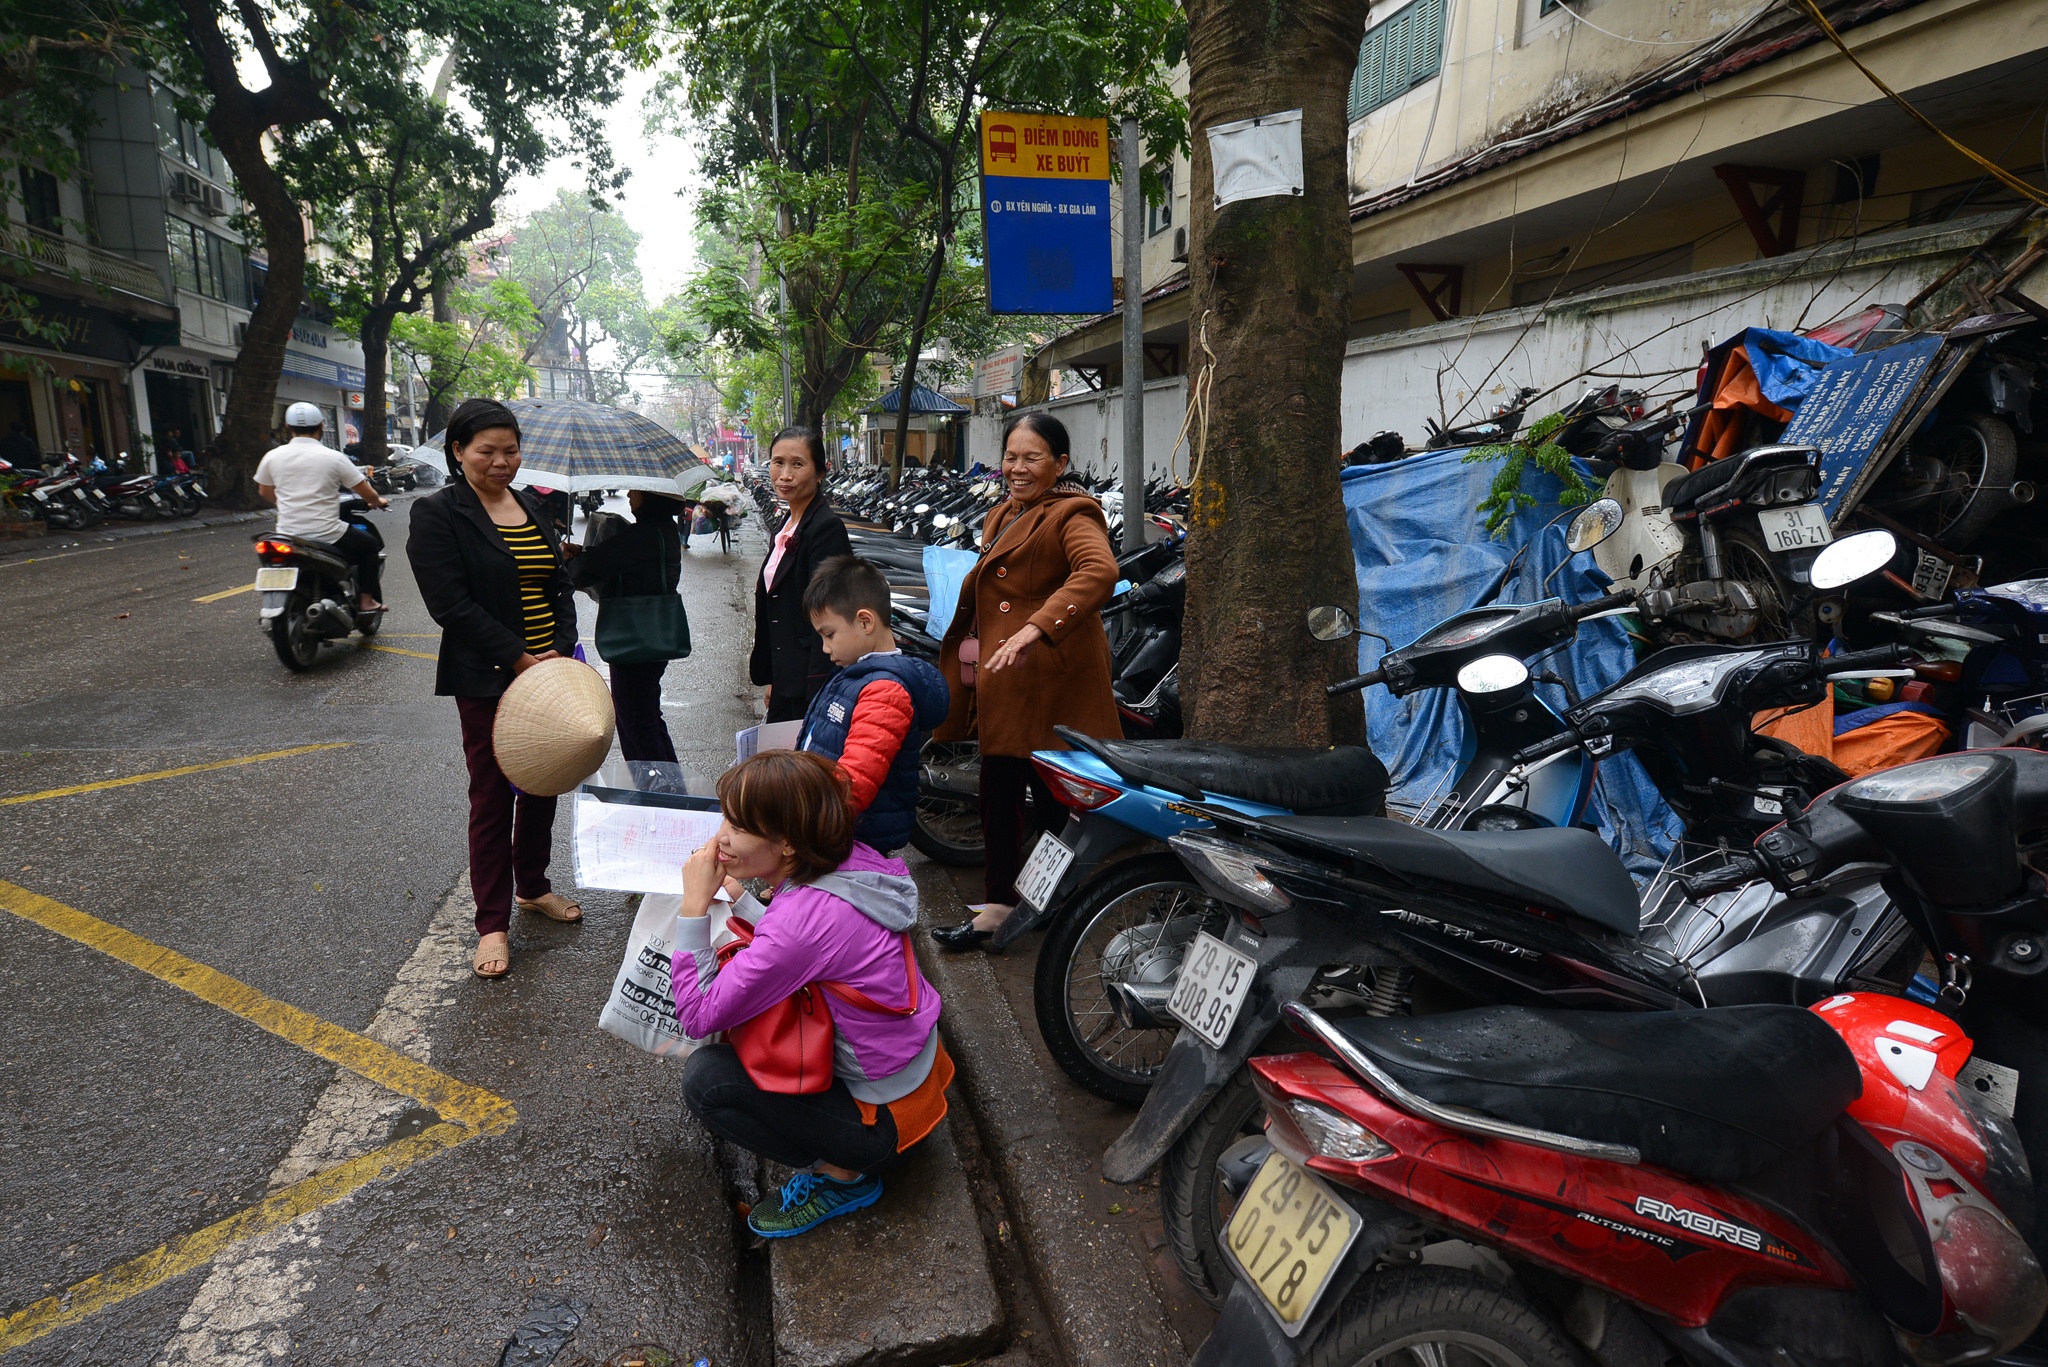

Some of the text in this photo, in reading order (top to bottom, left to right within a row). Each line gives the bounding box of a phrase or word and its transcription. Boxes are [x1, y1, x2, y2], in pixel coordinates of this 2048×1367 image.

[1024, 120, 1099, 148] ĐIỂM DỪNG
[1036, 152, 1090, 173] XE BUÝT
[1006, 201, 1015, 211] BX
[1058, 203, 1068, 213] BX
[1069, 204, 1081, 215] GIA
[1082, 203, 1096, 215] LÂM
[292, 328, 327, 348] SUZUKI
[1807, 423, 1819, 434] XE
[1827, 390, 1839, 402] XE
[1834, 370, 1852, 389] MÁY
[1826, 486, 1840, 499] XE
[1834, 466, 1852, 485] MÁY
[1784, 510, 1804, 528] 31
[1773, 525, 1826, 548] 160-Z1
[634, 963, 655, 979] TRONG
[1192, 942, 1247, 996] 29-Y5
[622, 983, 645, 1000] BẢO
[618, 997, 640, 1013] TRONG
[640, 1009, 656, 1024] 06
[1173, 977, 1232, 1040] 308.96
[1260, 1160, 1342, 1255] 29-V5
[1577, 1212, 1675, 1246] AUTOMATIC
[1635, 1196, 1797, 1261] AMORE mio
[1234, 1207, 1307, 1308] 0178
